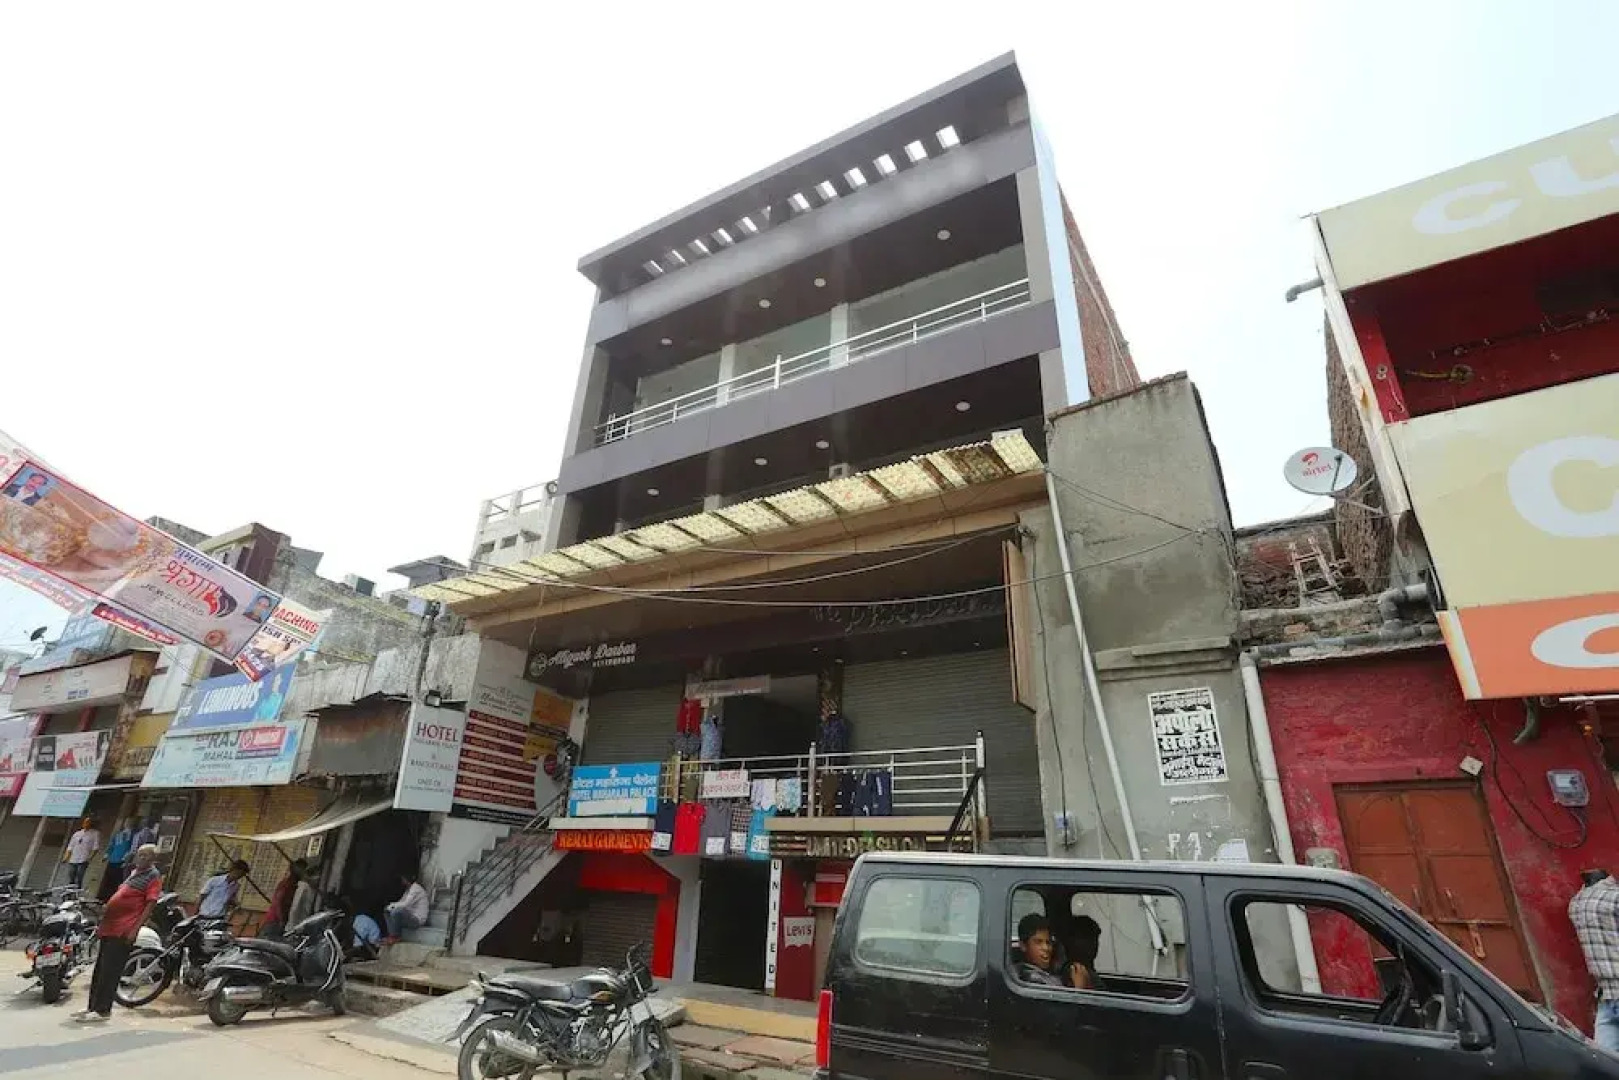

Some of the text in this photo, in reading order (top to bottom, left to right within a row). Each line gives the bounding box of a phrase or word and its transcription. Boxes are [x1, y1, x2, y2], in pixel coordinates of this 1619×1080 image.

[1302, 463, 1334, 477] airtel
[140, 584, 205, 616] JEWELLERS
[207, 731, 239, 748] RAJ
[416, 721, 459, 743] HOTEL
[593, 830, 651, 849] GARMENTS
[768, 861, 778, 974] UNITED
